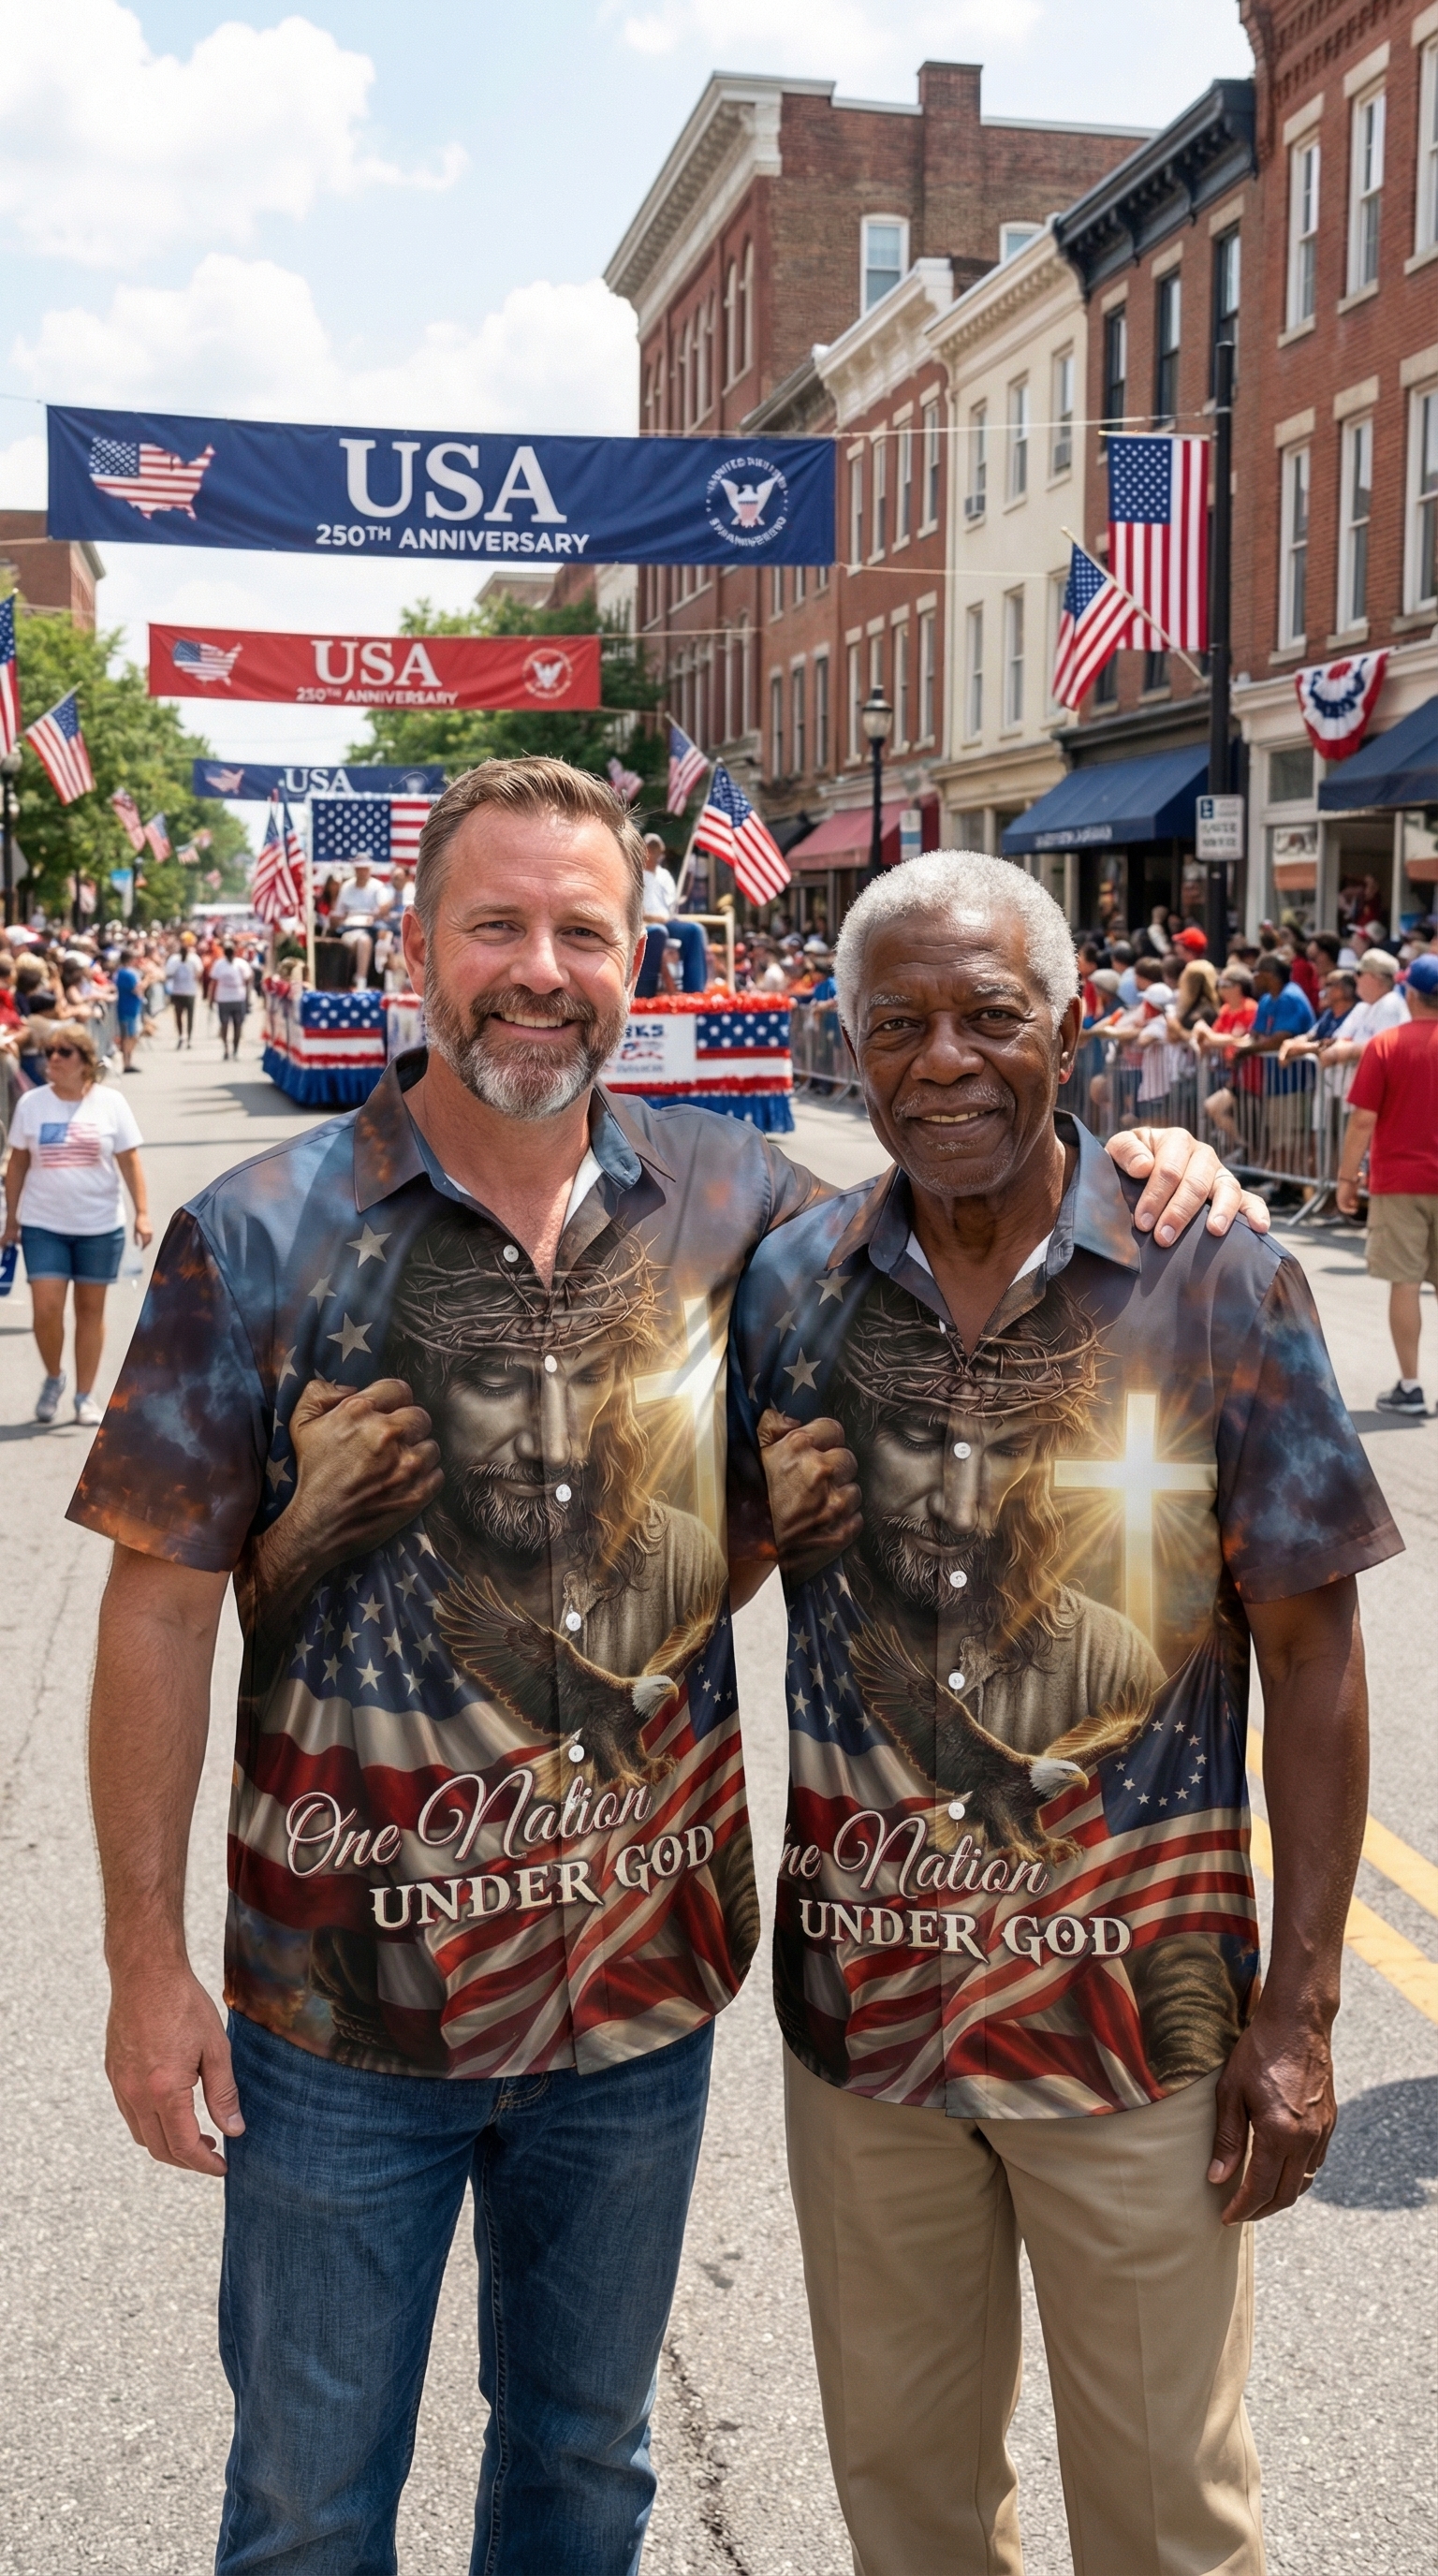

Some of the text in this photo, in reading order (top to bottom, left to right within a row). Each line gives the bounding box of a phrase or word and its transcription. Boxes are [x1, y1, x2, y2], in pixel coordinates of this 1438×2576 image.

[339, 438, 567, 523] USA
[315, 523, 590, 554] 250TH ANNIVERSARY
[310, 640, 443, 687] USA
[344, 689, 459, 705] ANNIVERSARY
[283, 768, 355, 793] USA
[286, 1769, 653, 1878] One Nation
[780, 1810, 1049, 1899] ne Nation
[370, 1824, 714, 1928] UNDER GOD
[799, 1898, 1133, 1967] UNDER GOD
